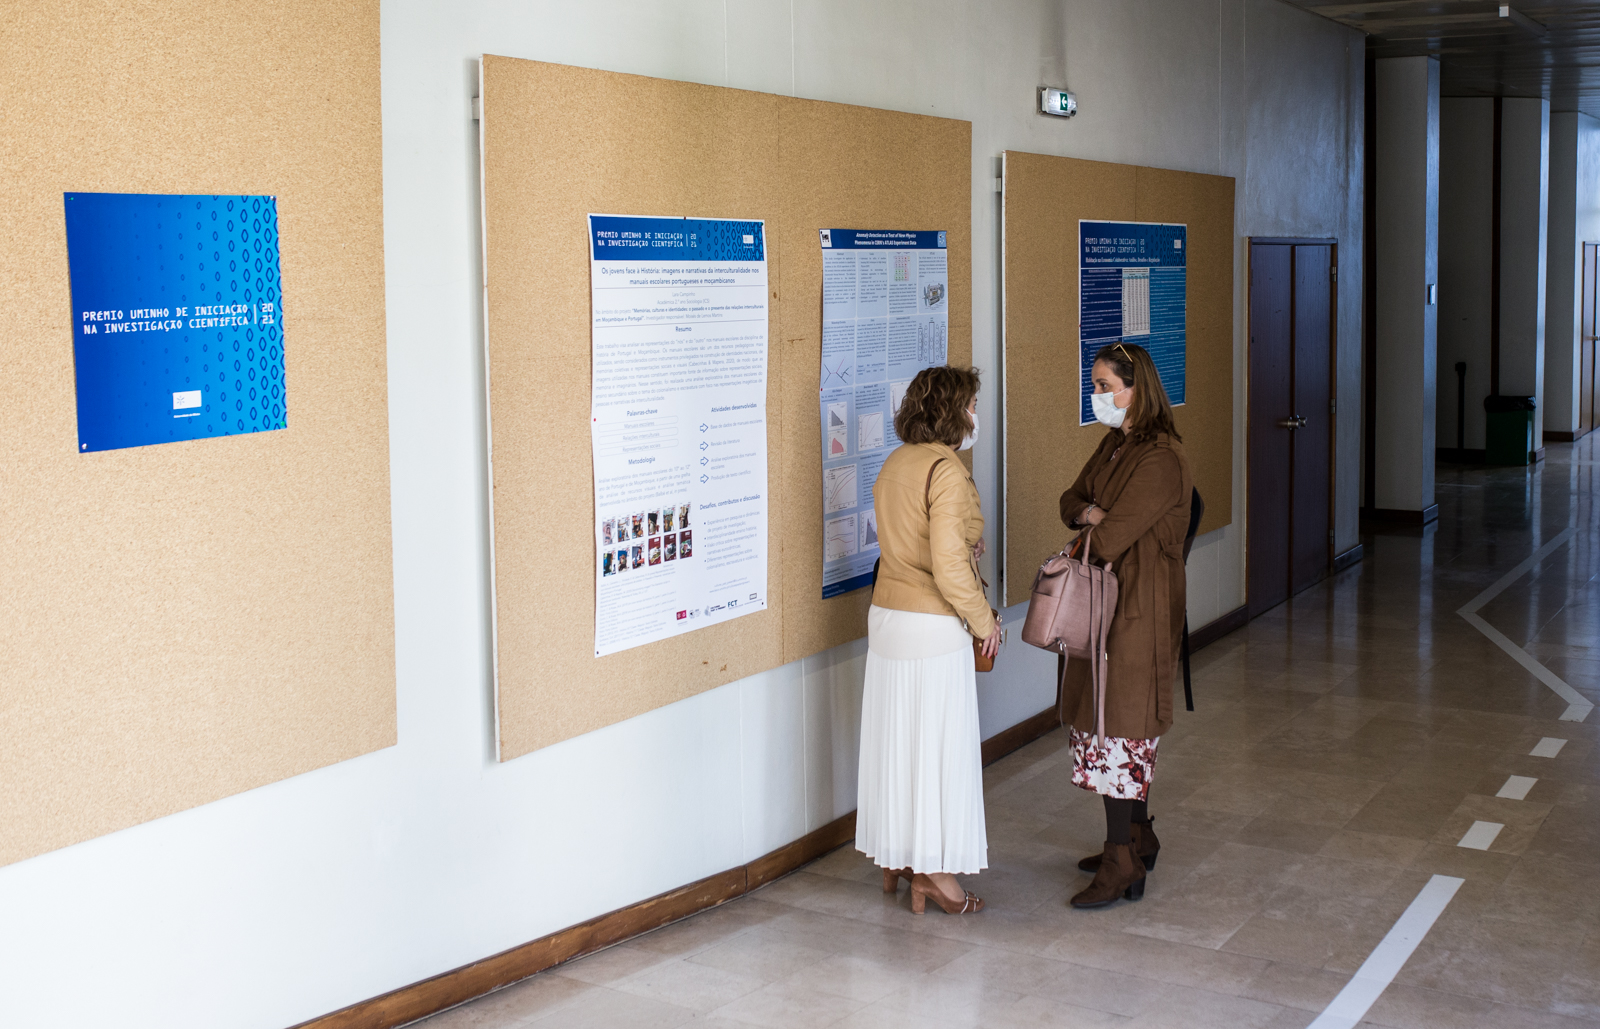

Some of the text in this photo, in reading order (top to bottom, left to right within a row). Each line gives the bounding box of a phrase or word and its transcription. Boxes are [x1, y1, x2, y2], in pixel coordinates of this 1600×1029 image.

[609, 267, 624, 275] jovens
[662, 267, 680, 275] imagens
[704, 277, 735, 285] moçambicanos
[130, 308, 169, 319] UMINHO
[176, 307, 188, 317] DE
[262, 303, 273, 312] 20
[84, 315, 274, 334] NA INVESTIGAÇÃO CIENTÍFICA 21
[732, 402, 757, 410] desenvolvidas
[627, 408, 658, 416] Palavras-chave
[628, 456, 655, 464] Metodologia
